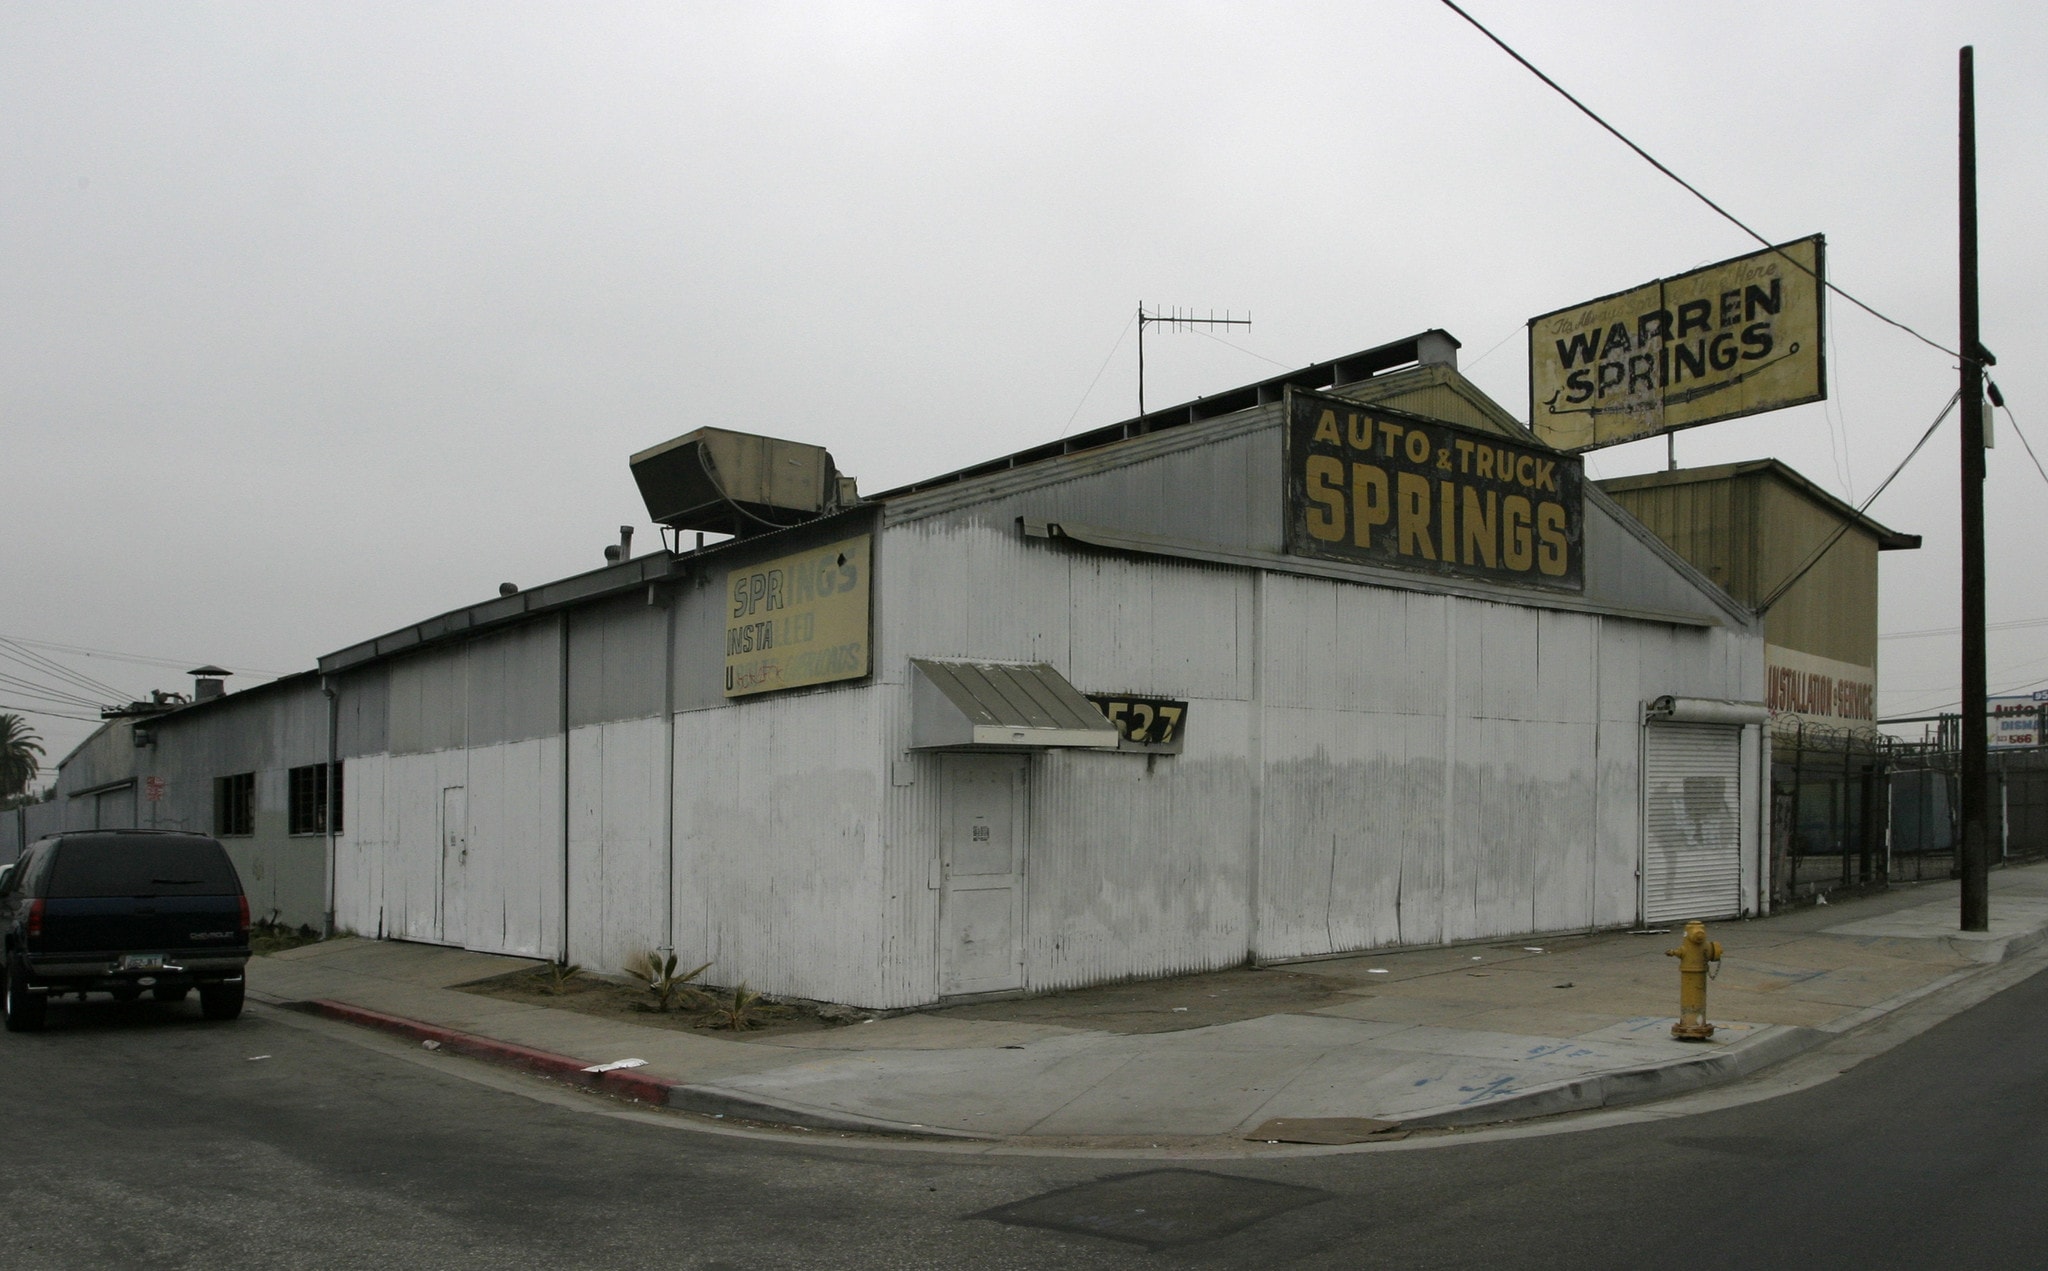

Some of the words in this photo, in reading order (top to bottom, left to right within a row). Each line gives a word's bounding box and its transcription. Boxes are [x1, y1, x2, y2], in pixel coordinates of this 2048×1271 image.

[1734, 261, 1778, 284] Here
[1556, 279, 1782, 370] WARREN
[1566, 322, 1774, 403] SPRINGS
[1314, 409, 1431, 464] AUTO
[1436, 448, 1453, 472] &
[1456, 439, 1556, 492] TRUCK
[1305, 454, 1568, 577] SPRINGS
[733, 548, 858, 618] SPRINGS
[1090, 701, 1183, 744] 527
[1767, 664, 1833, 717] INSTALLATION
[1838, 678, 1873, 721] SERVICE
[1995, 704, 2035, 718] Auto
